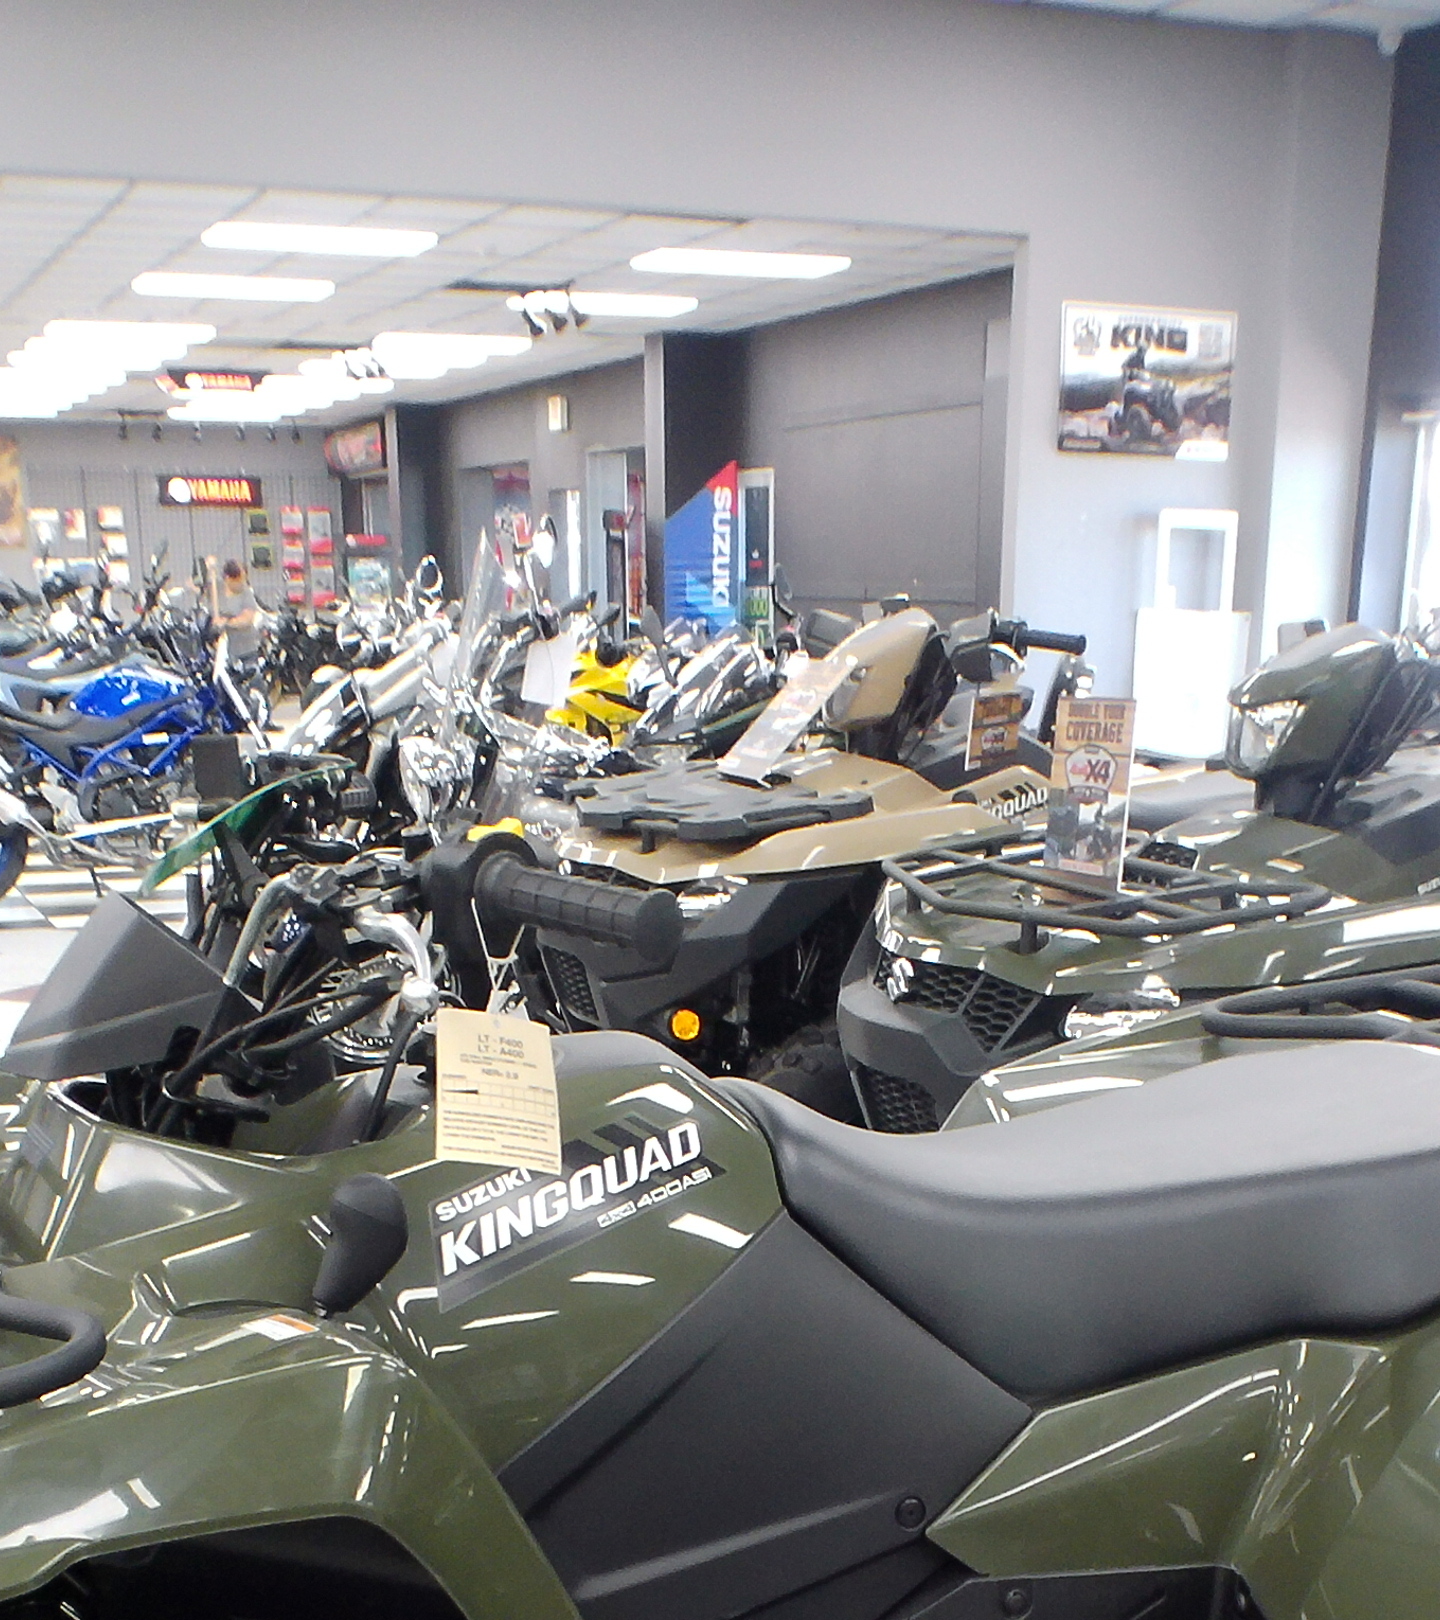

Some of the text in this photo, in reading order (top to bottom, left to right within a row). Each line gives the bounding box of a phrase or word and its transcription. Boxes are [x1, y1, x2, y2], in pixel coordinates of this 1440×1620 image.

[187, 479, 252, 502] YAMAHA
[713, 486, 733, 607] SUZUKI
[1066, 720, 1124, 743] COVERAGE
[435, 1167, 531, 1222] SUZUKI
[440, 1120, 702, 1277] KINGQUAD
